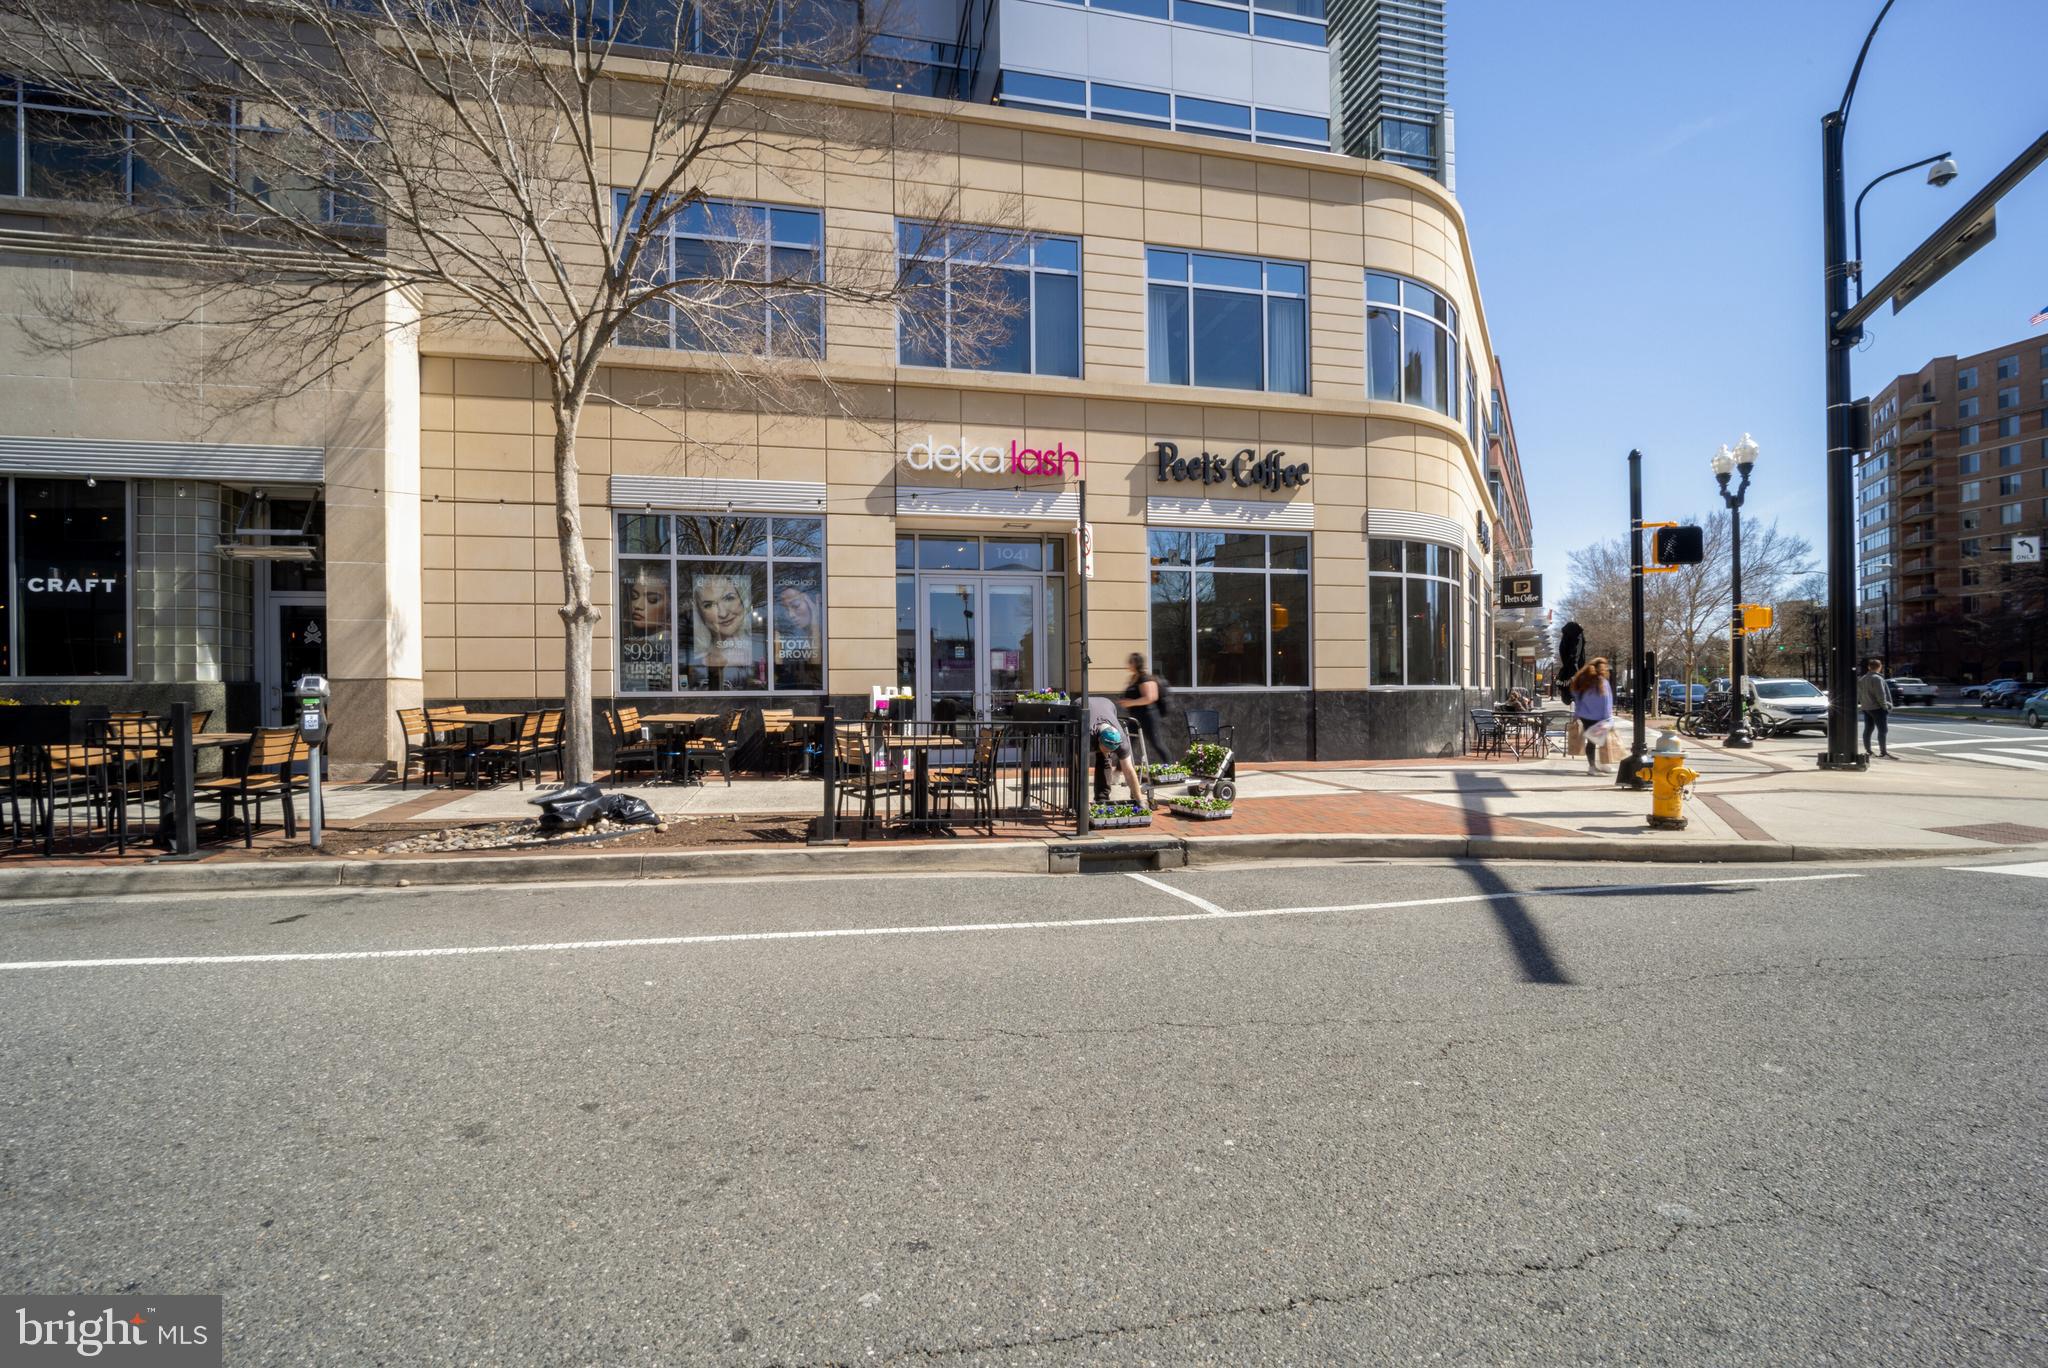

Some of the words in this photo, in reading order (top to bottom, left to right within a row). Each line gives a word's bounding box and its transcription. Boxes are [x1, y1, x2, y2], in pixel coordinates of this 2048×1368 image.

[1154, 441, 1227, 485] Peet's
[1231, 449, 1310, 492] Coffee
[995, 547, 1029, 561] 1041
[27, 577, 117, 593] CRAFT
[1520, 594, 1539, 603] Coffee
[624, 642, 671, 660] $99.99
[780, 639, 818, 650] TOTAL
[779, 649, 818, 659] BROWS
